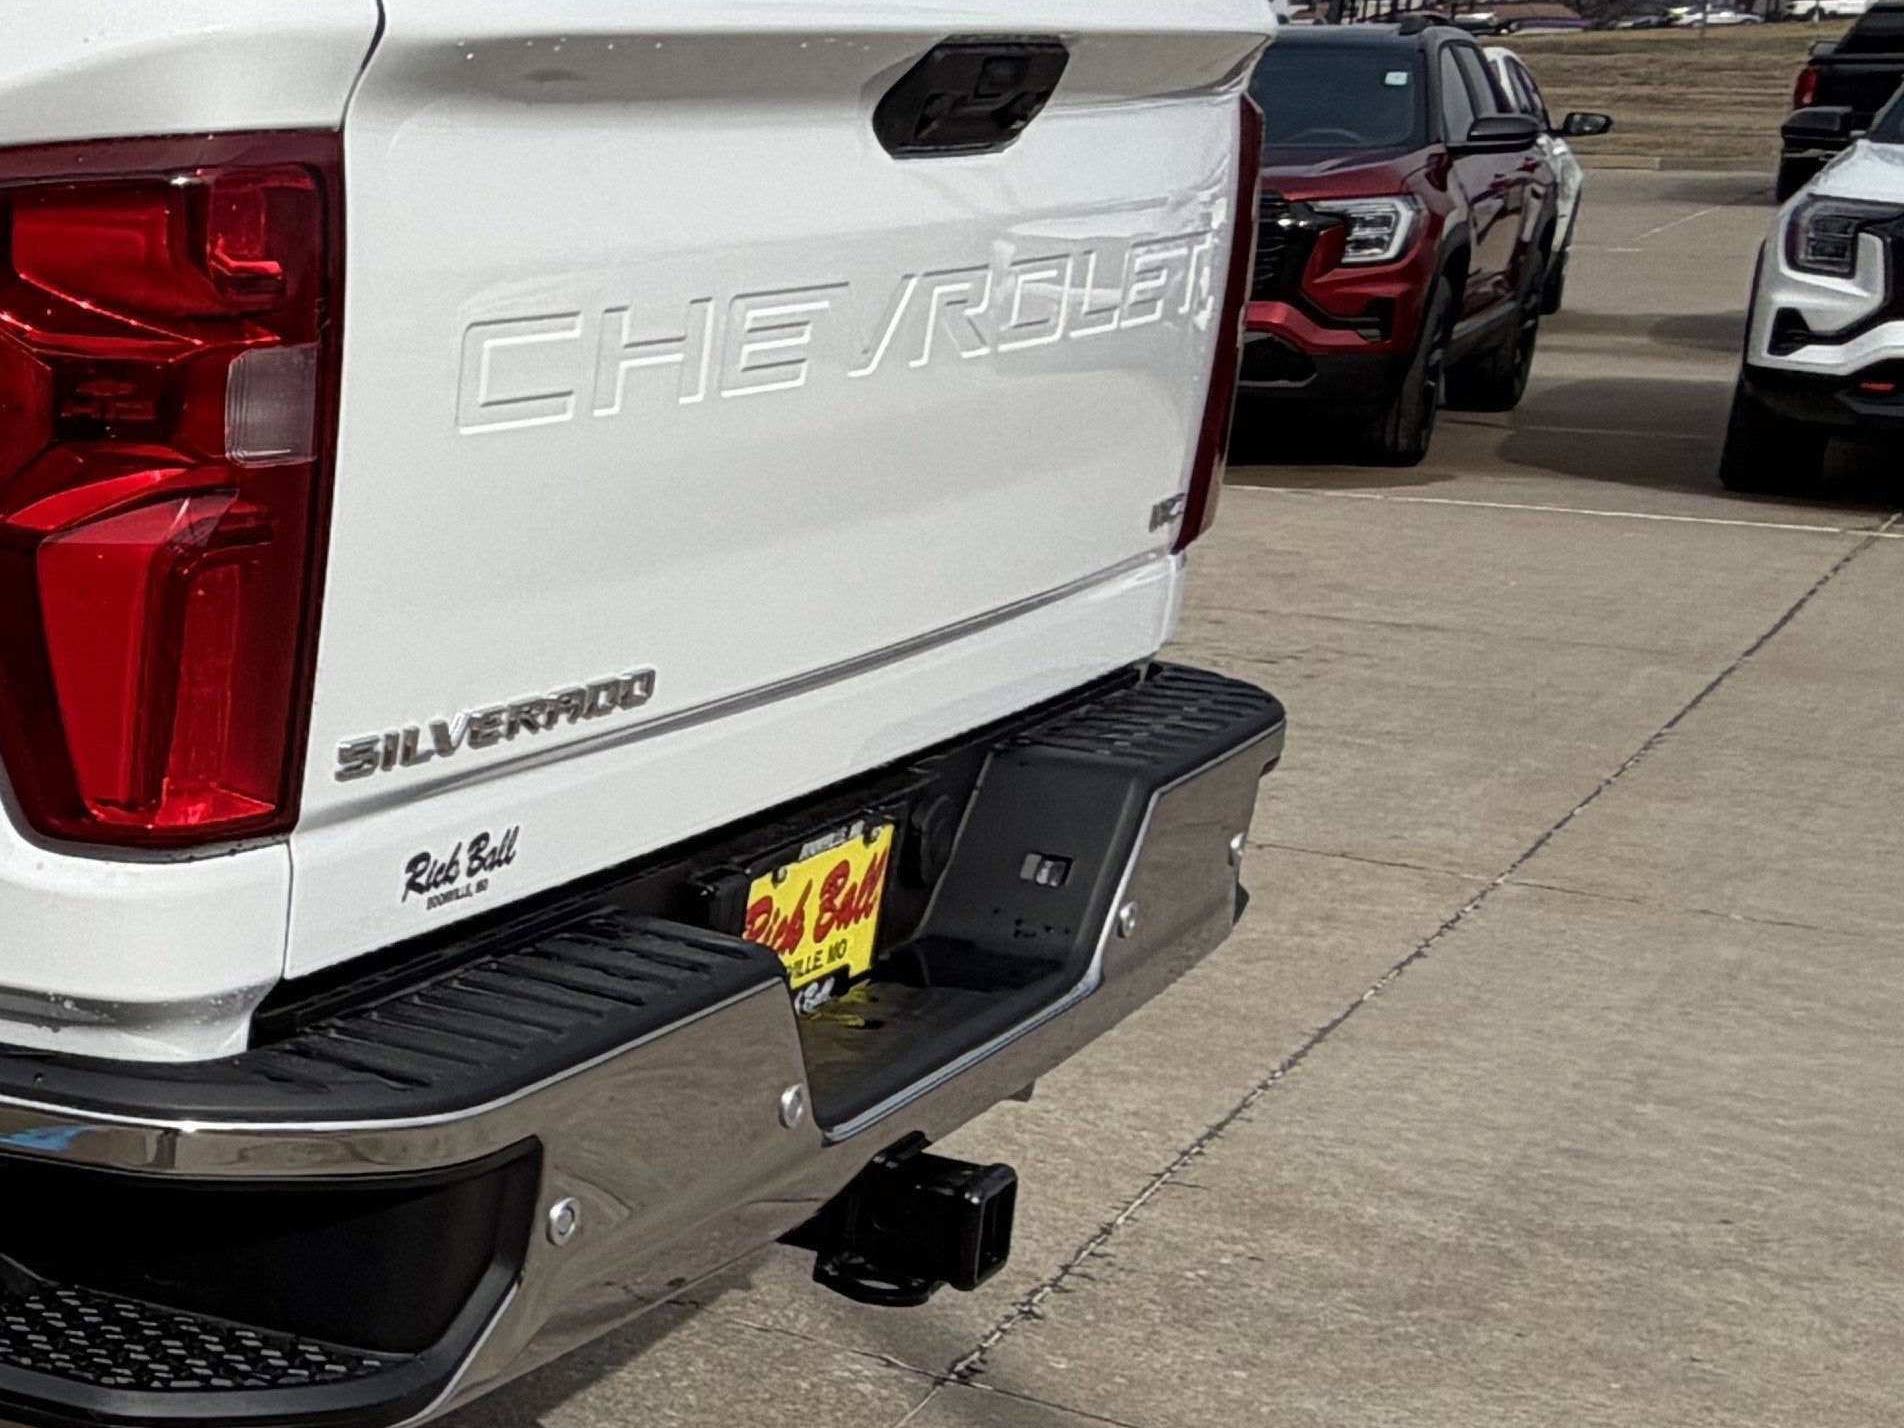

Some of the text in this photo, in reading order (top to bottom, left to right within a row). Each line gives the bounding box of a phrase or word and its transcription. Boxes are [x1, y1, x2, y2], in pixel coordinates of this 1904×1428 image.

[455, 227, 1214, 434] CHEVROLET
[335, 665, 656, 783] SILVERADO
[400, 824, 521, 904] Rick Ball
[743, 847, 889, 956] Rick Ball
